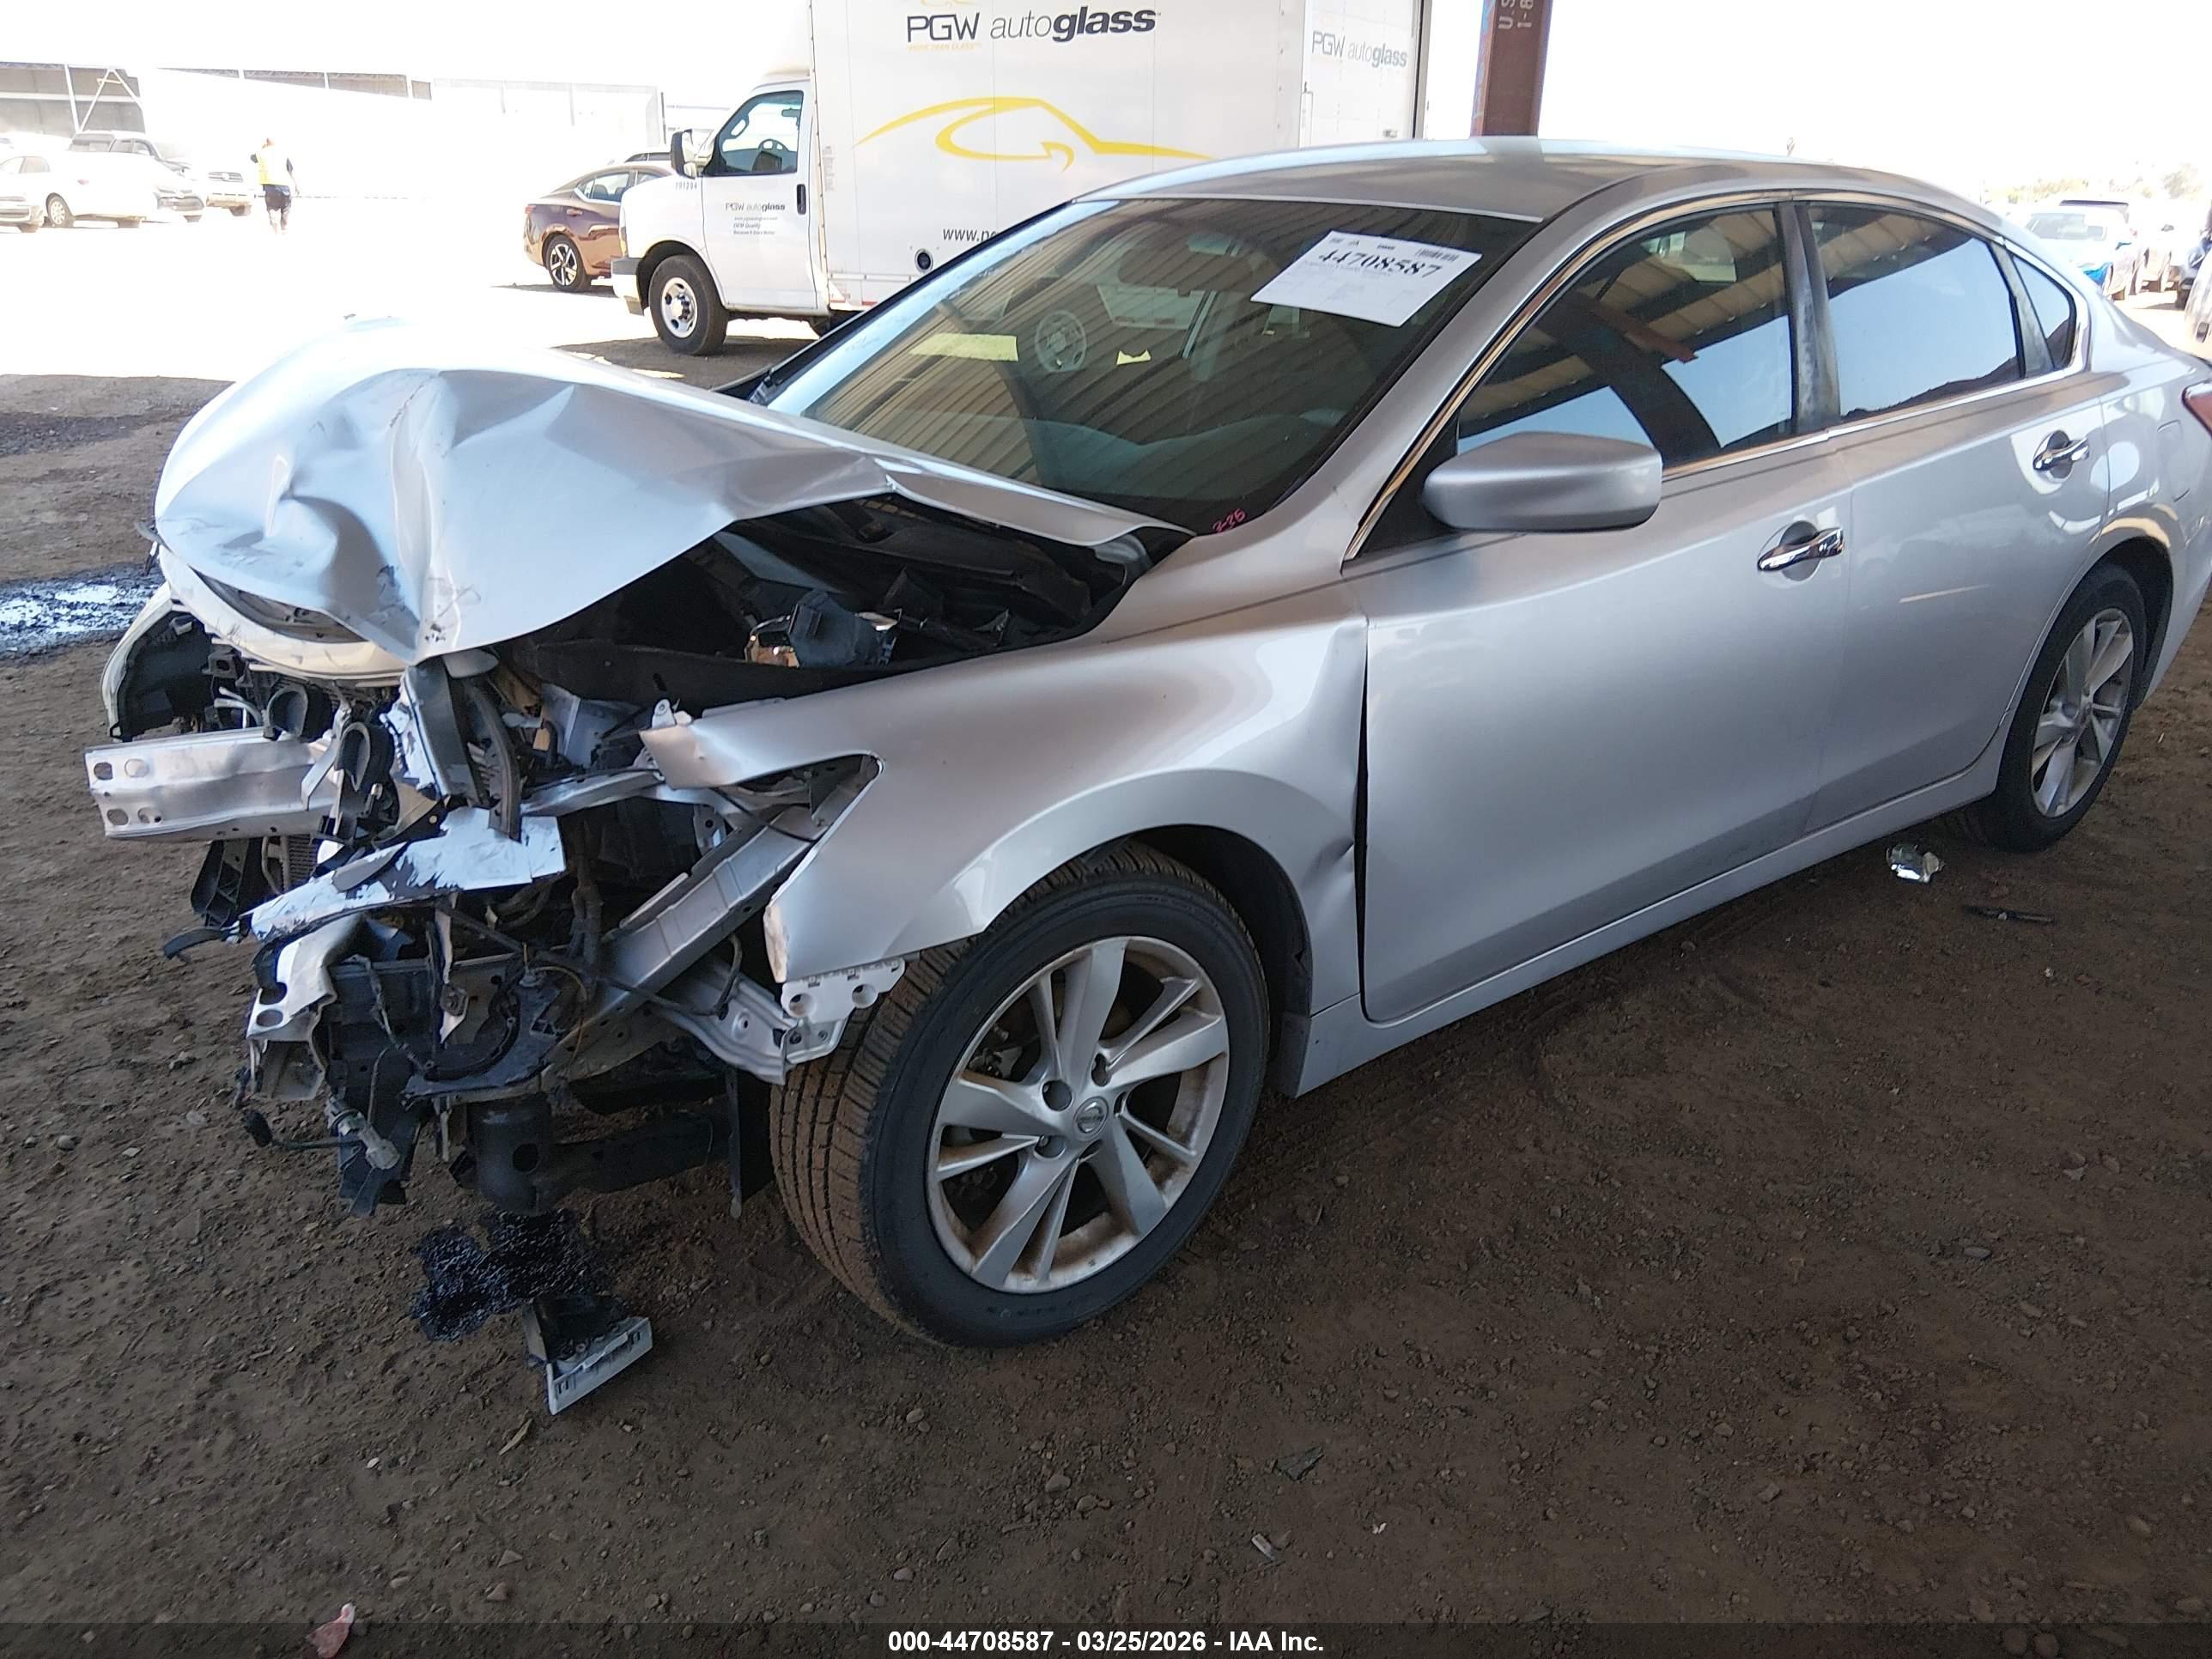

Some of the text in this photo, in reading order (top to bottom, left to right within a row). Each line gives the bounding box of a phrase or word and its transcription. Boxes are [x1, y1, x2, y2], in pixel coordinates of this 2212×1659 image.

[907, 5, 1157, 43] PGW autoglass
[1311, 30, 1408, 68] PGW autoglass
[1319, 249, 1443, 278] 44708587
